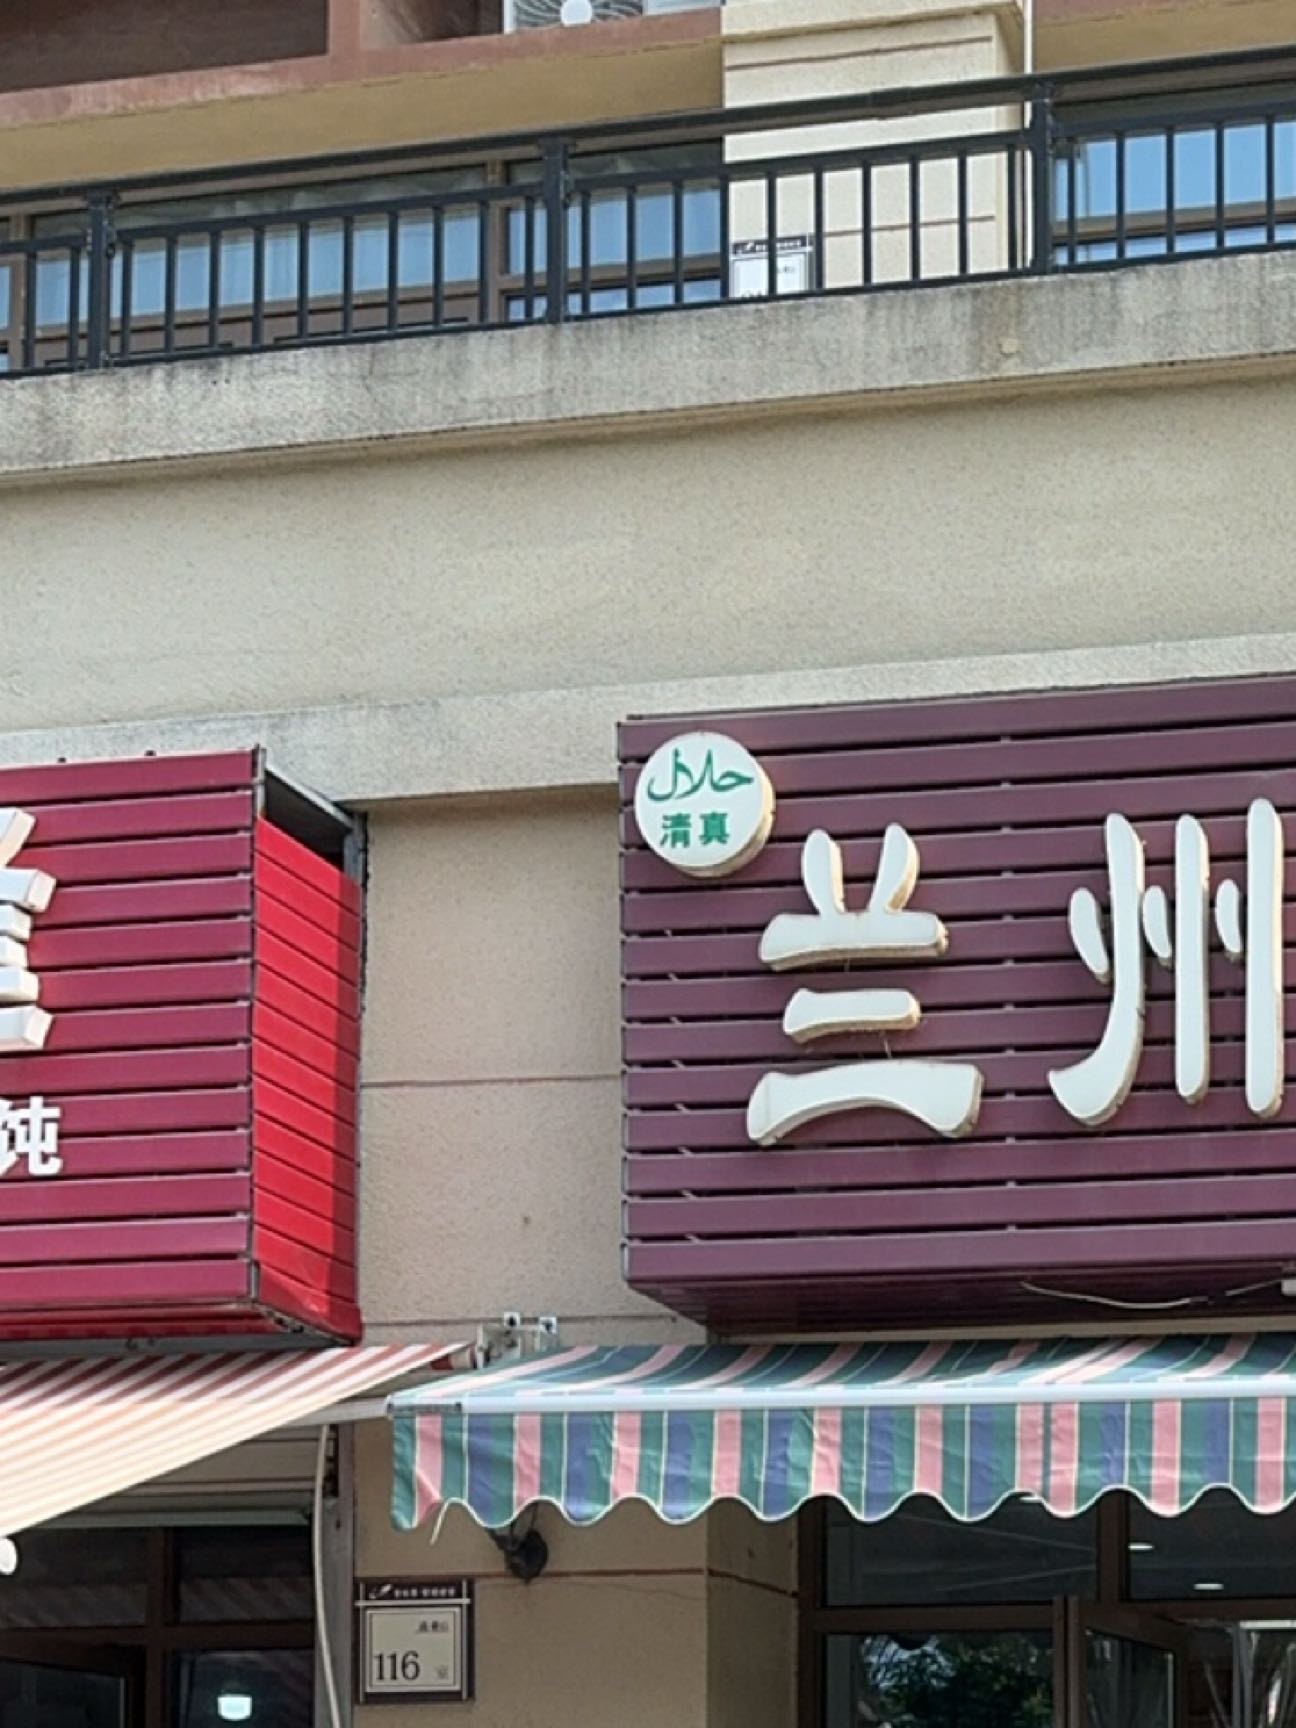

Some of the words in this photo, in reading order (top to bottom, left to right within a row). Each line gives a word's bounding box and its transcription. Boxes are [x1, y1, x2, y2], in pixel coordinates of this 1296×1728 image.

[648, 747, 755, 801] حلال
[660, 811, 730, 848] 清真
[373, 1650, 420, 1681] 116
